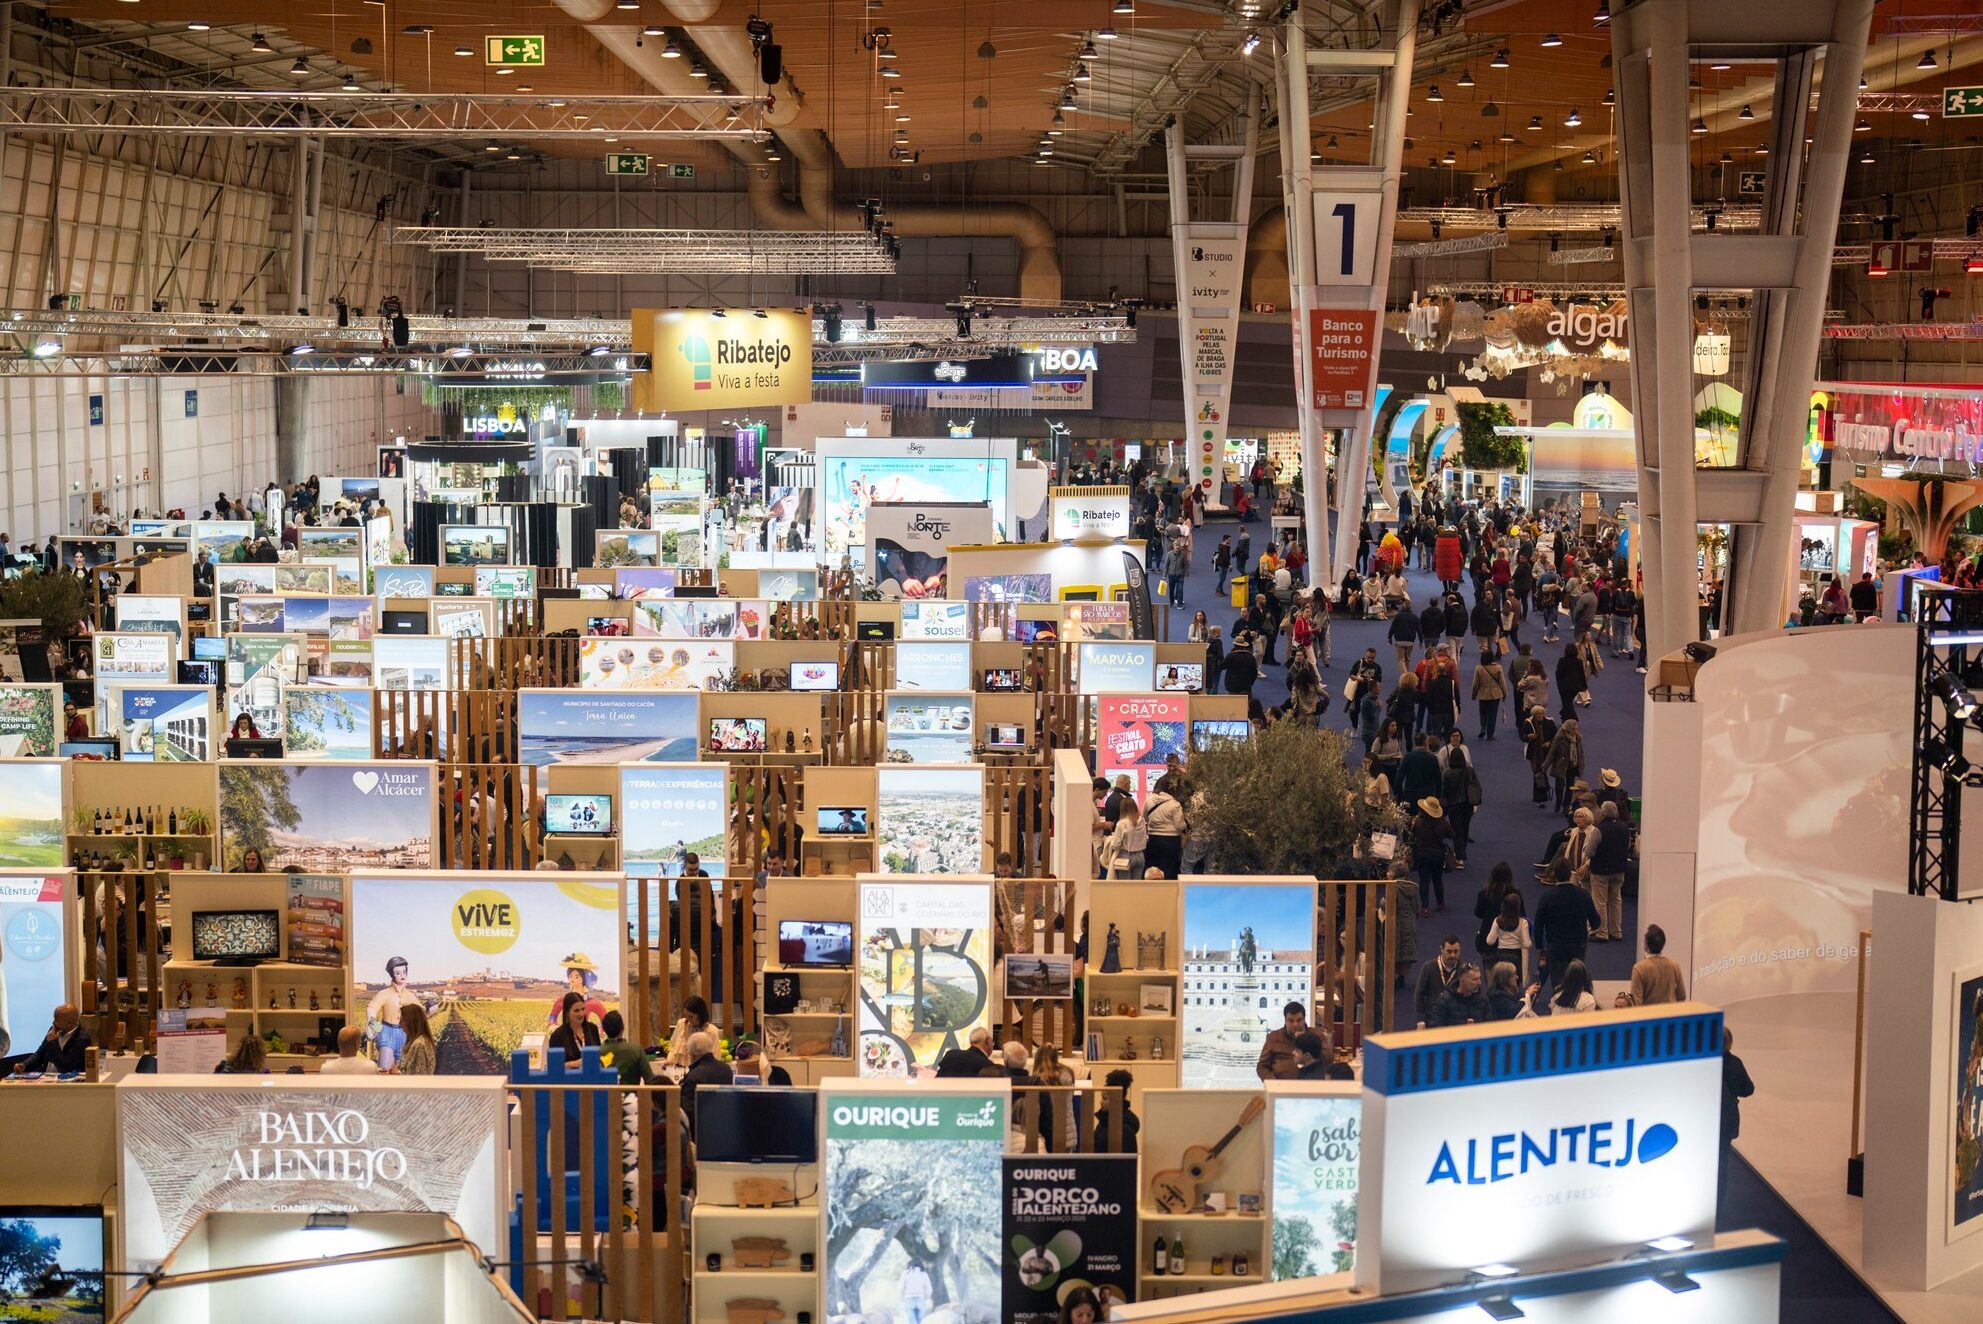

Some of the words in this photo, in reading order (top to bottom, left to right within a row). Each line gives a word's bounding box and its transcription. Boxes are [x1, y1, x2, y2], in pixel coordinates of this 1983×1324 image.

[1332, 203, 1355, 275] 1
[1192, 287, 1219, 298] ivity
[1322, 319, 1364, 331] Banco
[1322, 334, 1351, 345] para
[1355, 335, 1363, 344] o
[718, 339, 791, 369] Ribatejo
[1316, 346, 1368, 358] Turismo
[718, 374, 741, 389] Viva
[745, 378, 751, 388] a
[755, 373, 780, 388] festa
[463, 418, 526, 433] LISBOA
[1893, 418, 1955, 460] Centro
[1082, 509, 1120, 521] Ribatejo
[924, 626, 964, 636] sousel
[1089, 652, 1145, 665] MARVÃO
[1119, 703, 1168, 715] CRATO
[1108, 730, 1141, 744] FESTIVAL
[1116, 739, 1146, 754] CRATO
[381, 771, 419, 784] Amar
[375, 784, 425, 796] Alcácer
[314, 879, 341, 892] FIAPE
[460, 928, 516, 937] ESTREMOZ
[1751, 950, 1767, 965] do
[1771, 944, 1811, 962] saber
[1816, 943, 1839, 958] de
[833, 1106, 939, 1129] OURIQUE
[957, 1116, 995, 1128] Ourique
[259, 1109, 369, 1144] BAIXO
[1309, 1130, 1361, 1163] bor
[224, 1147, 406, 1190] ALENTEJO
[1314, 1167, 1355, 1179] CAST
[1013, 1169, 1076, 1181] OURIQUE
[1314, 1179, 1356, 1190] VERD
[1017, 1187, 1099, 1215] PORCO
[271, 1205, 307, 1213] CIDADE
[1023, 1203, 1120, 1215] ALENTEJANO
[1095, 1264, 1121, 1272] MARÇO
